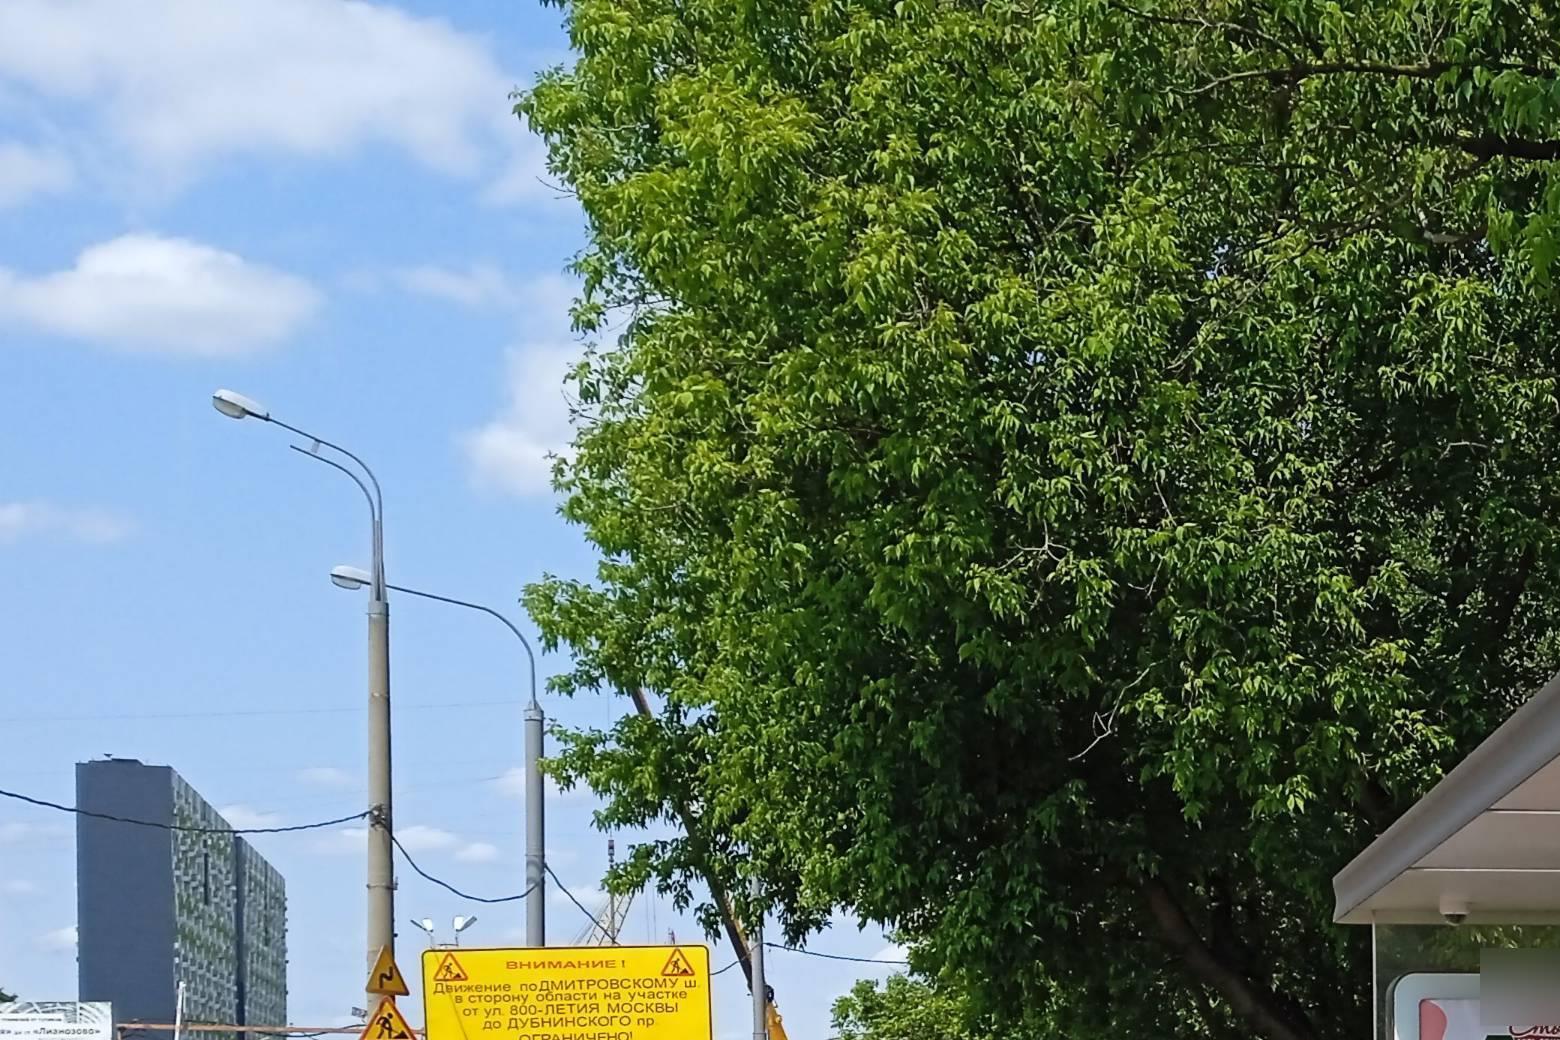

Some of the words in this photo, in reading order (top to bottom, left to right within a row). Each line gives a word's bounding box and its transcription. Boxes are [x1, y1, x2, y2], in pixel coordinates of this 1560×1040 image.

[506, 960, 617, 970] ВНИМАНИЕ
[433, 982, 511, 995] Движение
[455, 995, 463, 1003] в
[468, 993, 529, 1005] сторону
[536, 991, 597, 1002] области
[604, 992, 621, 1000] на
[628, 990, 687, 1002] участке
[463, 1007, 478, 1016] от
[510, 1002, 599, 1016] 800-ЛЕТИЯ
[607, 1002, 679, 1014] МОСКВЫ
[483, 1020, 501, 1030] до
[508, 1015, 631, 1031] ДУБНИНСКОГО
